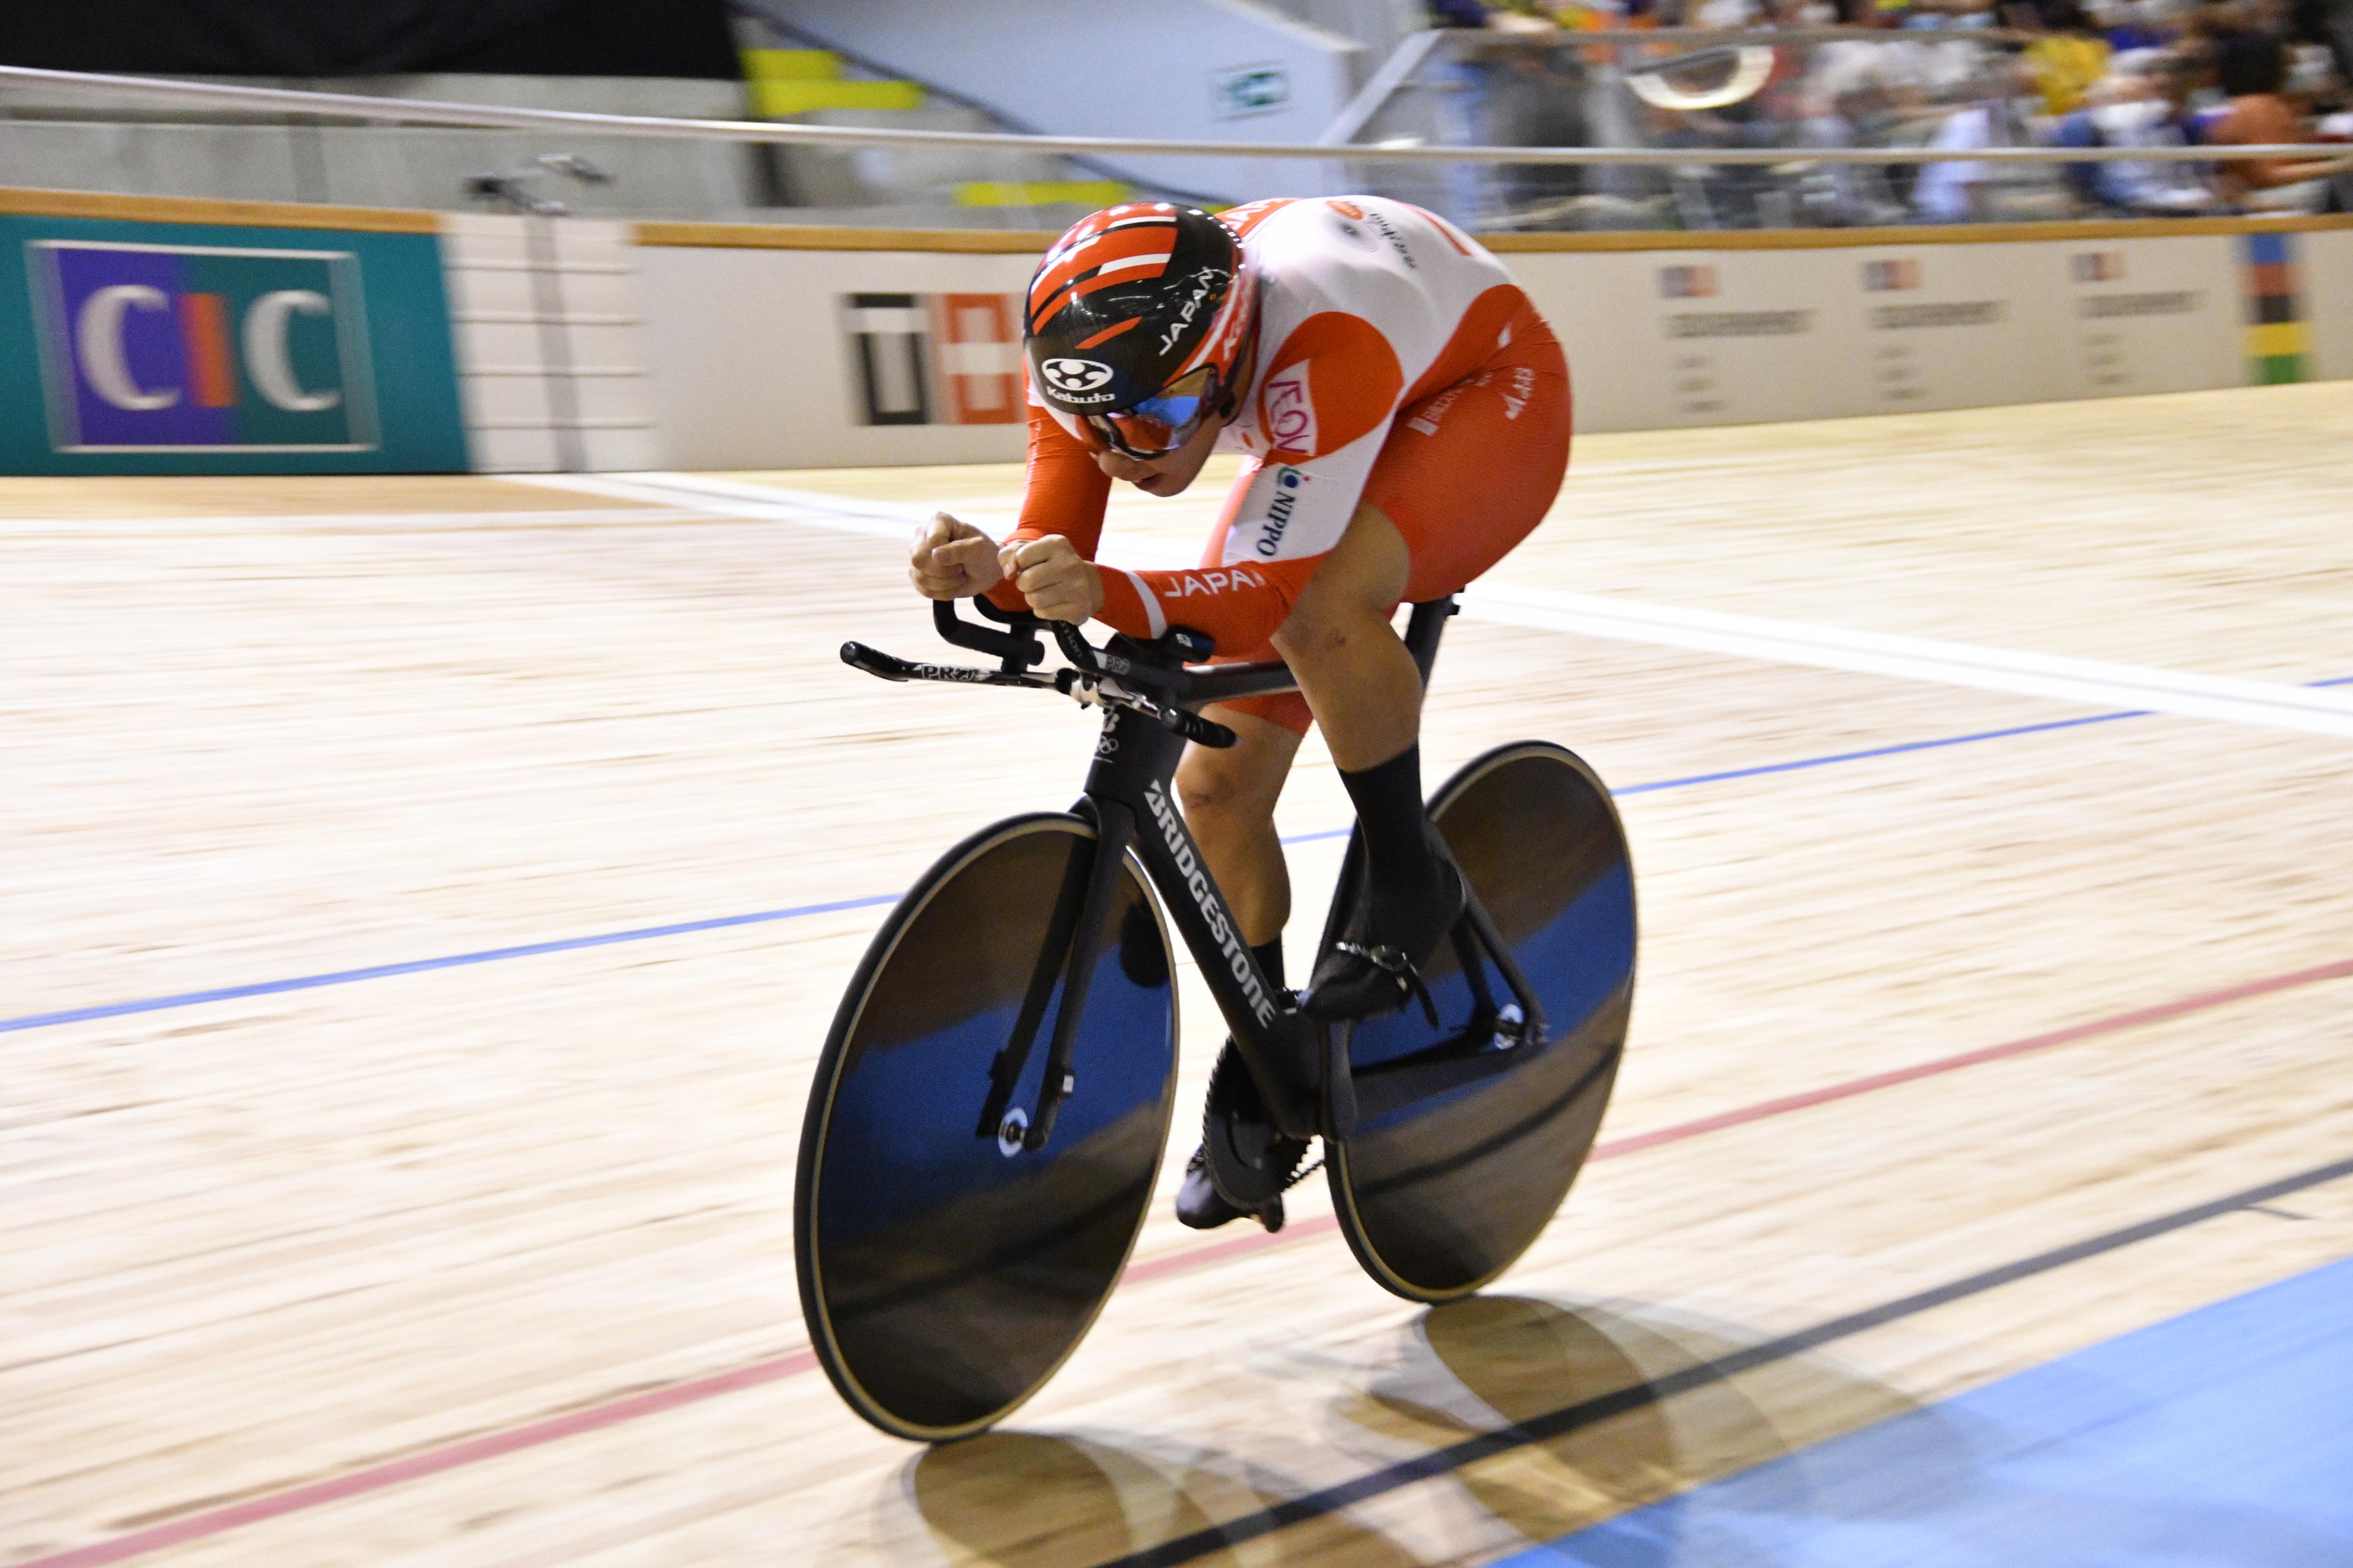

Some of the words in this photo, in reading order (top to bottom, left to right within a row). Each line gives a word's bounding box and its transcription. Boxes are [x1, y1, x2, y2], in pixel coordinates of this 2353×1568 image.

[76, 283, 343, 411] CIC
[1158, 266, 1215, 356] JAPAN
[1046, 385, 1115, 404] Kabuto
[1256, 491, 1297, 557] NIPPO
[1143, 778, 1278, 1030] BRIDGESTONE
